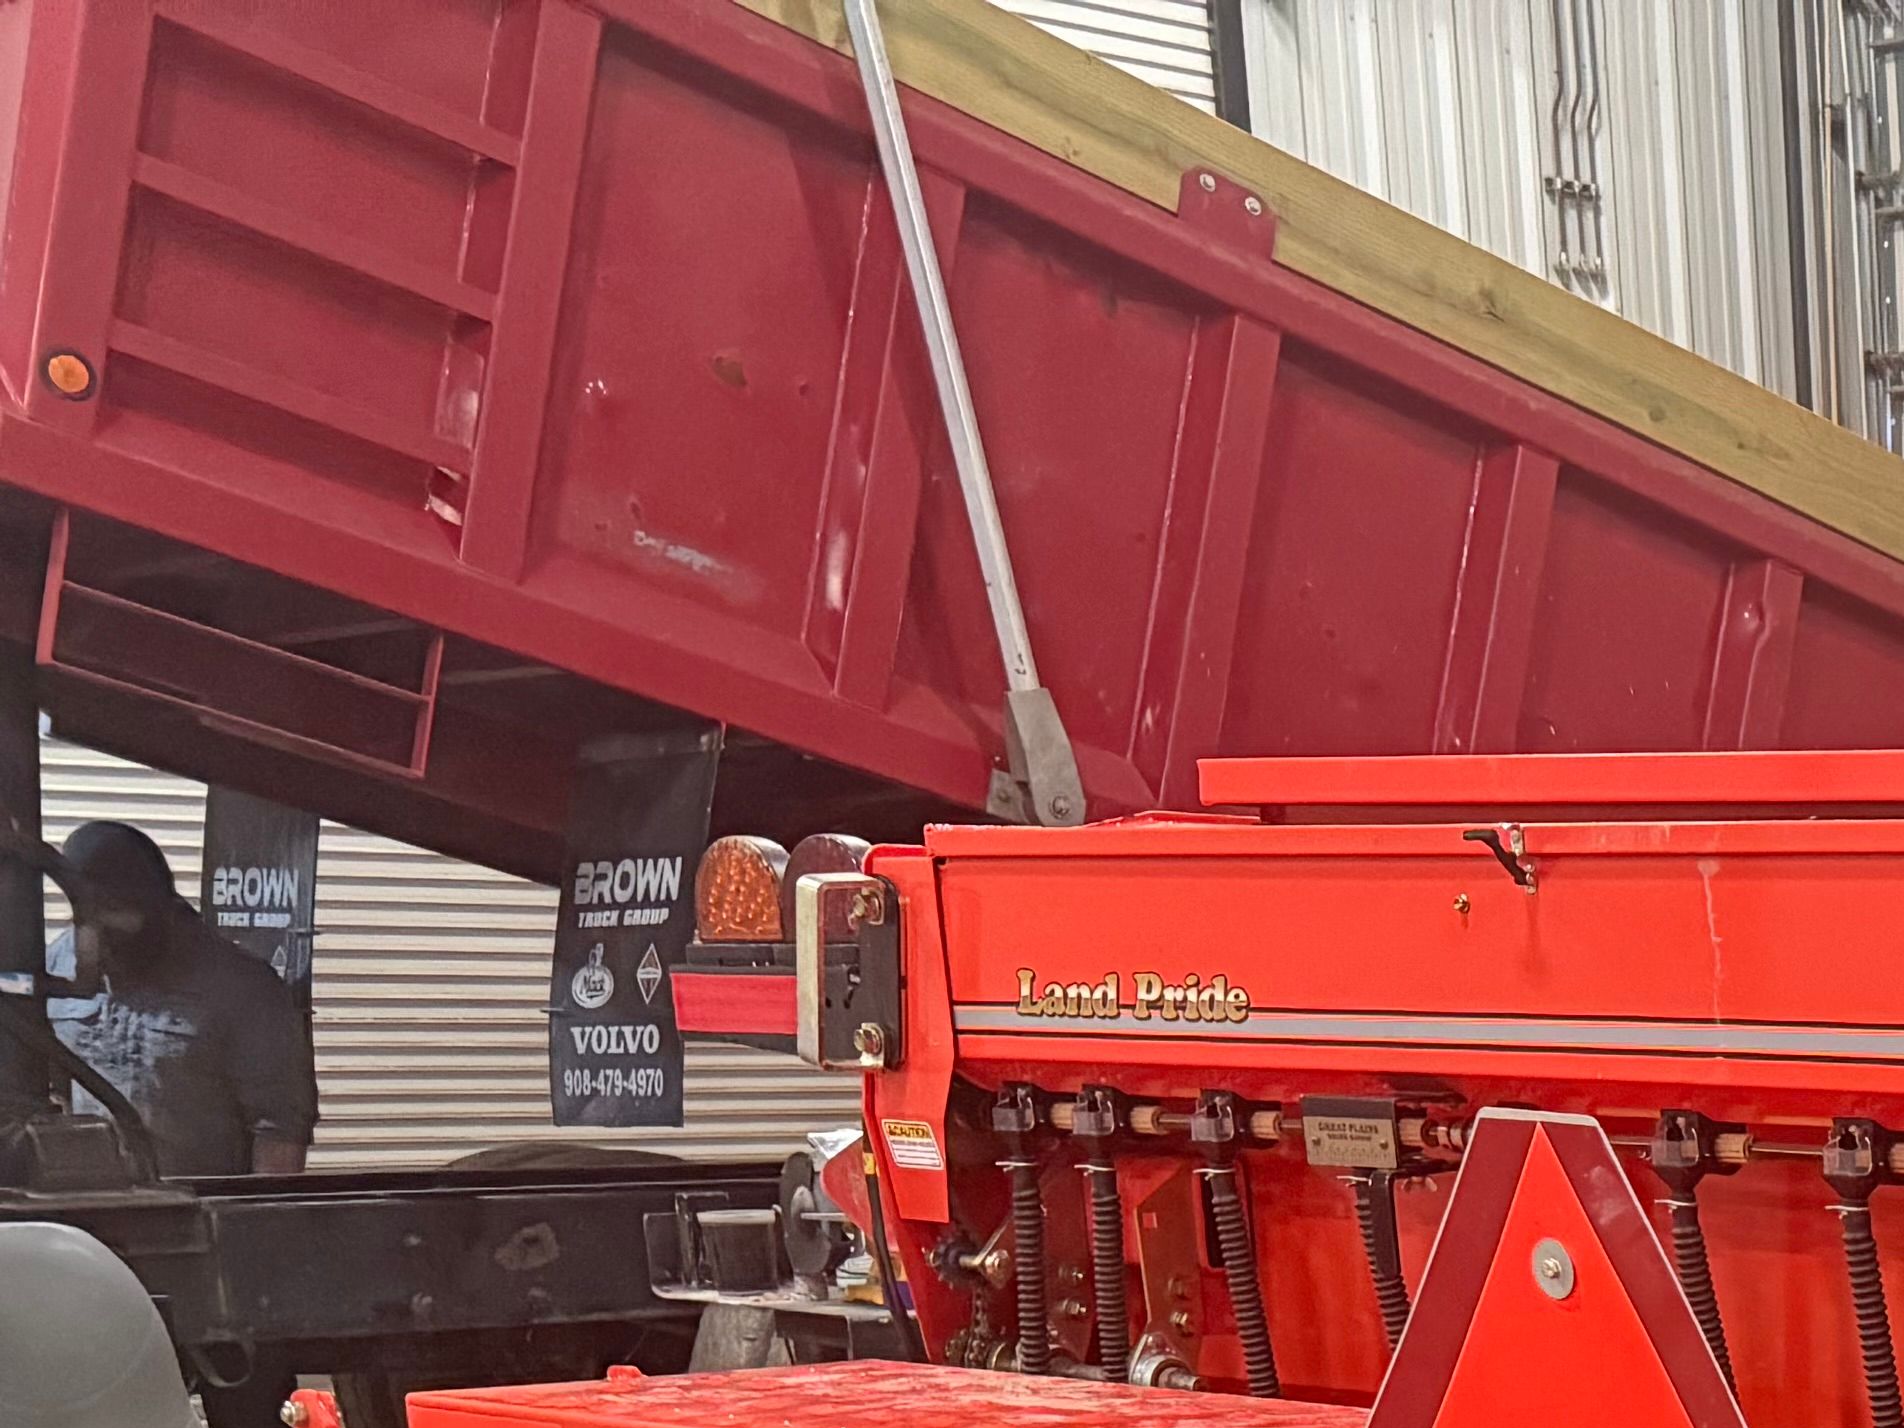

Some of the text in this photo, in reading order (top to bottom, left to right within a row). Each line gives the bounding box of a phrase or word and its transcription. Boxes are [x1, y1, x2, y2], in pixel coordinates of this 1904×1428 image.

[212, 866, 299, 908] BROWN
[574, 856, 683, 905] BROWN
[578, 907, 670, 929] TRUCK GROUP
[1015, 967, 1250, 1023] Land Pride
[570, 1024, 660, 1055] VOLVO
[563, 1066, 664, 1098] 908-479-4970
